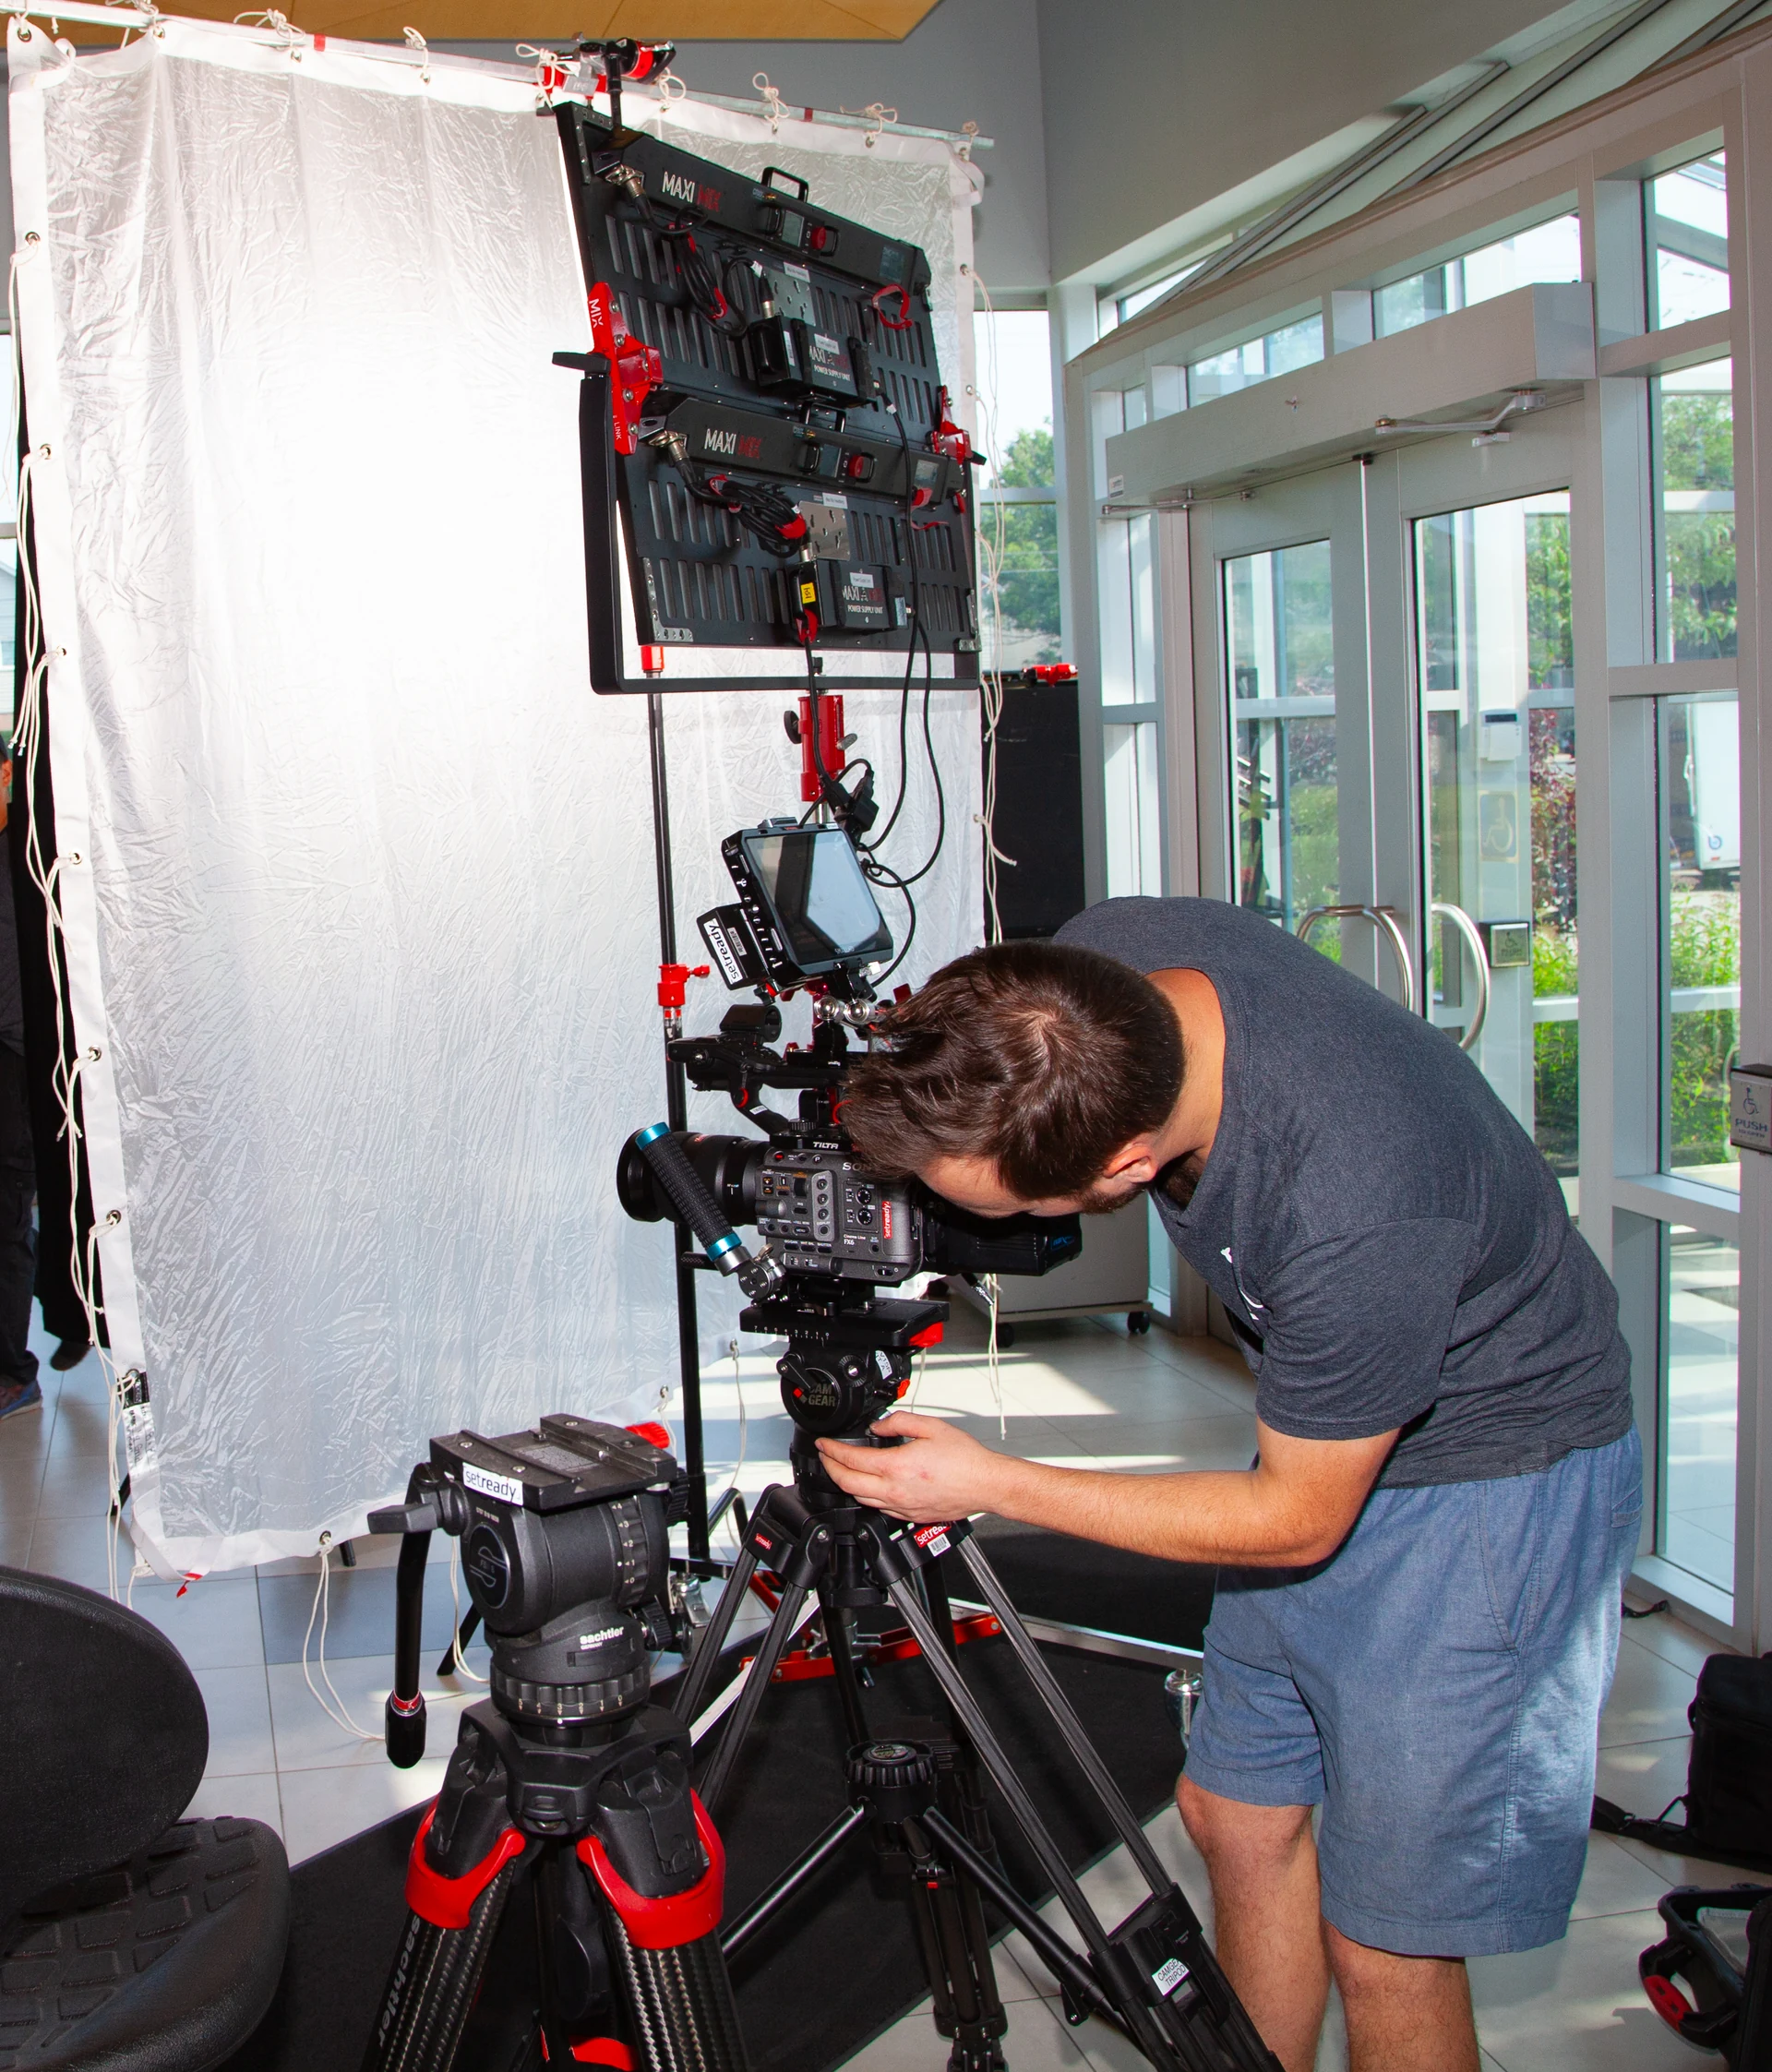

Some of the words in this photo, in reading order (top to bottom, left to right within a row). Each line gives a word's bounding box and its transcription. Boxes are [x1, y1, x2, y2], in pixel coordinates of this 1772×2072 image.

[662, 171, 696, 203] MAXI
[589, 298, 604, 329] MIX
[813, 364, 828, 376] POWER
[841, 372, 851, 381] UNIT
[614, 421, 622, 440] LINK
[704, 427, 736, 455] MAXI
[847, 605, 861, 613] POWER
[861, 605, 874, 614] SUPPLY
[709, 924, 739, 979] setready
[1735, 1118, 1768, 1132] PUSH
[812, 1141, 839, 1150] TILTA
[882, 1201, 892, 1238] setready
[808, 1383, 832, 1395] AM
[808, 1395, 835, 1407] GEAR
[465, 1470, 517, 1503] setready
[623, 1520, 629, 1528] 3
[629, 1539, 634, 1548] 2
[580, 1626, 624, 1645] sachtler
[378, 1914, 420, 2047] sachtler
[1165, 1964, 1187, 1987] TRIPOD
